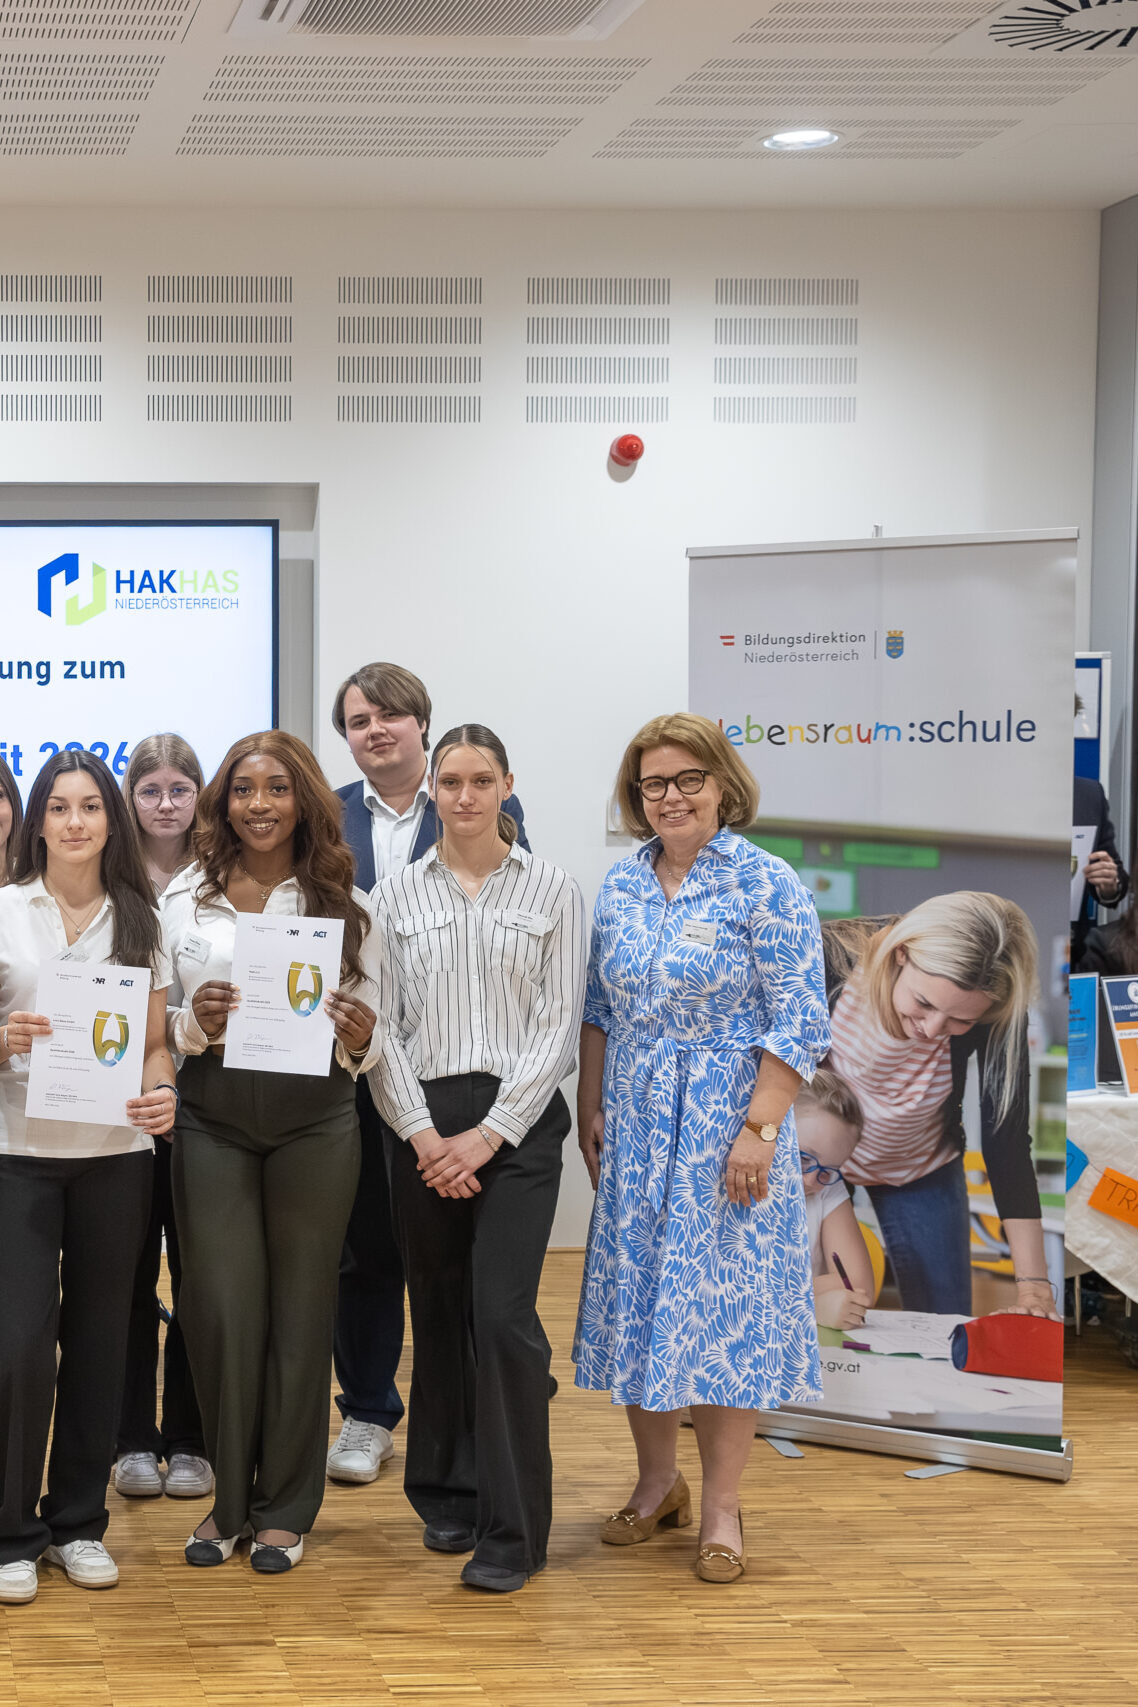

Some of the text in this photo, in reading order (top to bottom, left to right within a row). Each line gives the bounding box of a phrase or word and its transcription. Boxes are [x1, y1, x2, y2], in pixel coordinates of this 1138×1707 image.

[115, 596, 239, 609] NIEDERÖSTERREICH
[744, 631, 866, 648] Bildungsdirektion
[744, 650, 859, 664] Niederösterreich
[63, 660, 126, 680] zum
[1106, 1178, 1138, 1211] TR
